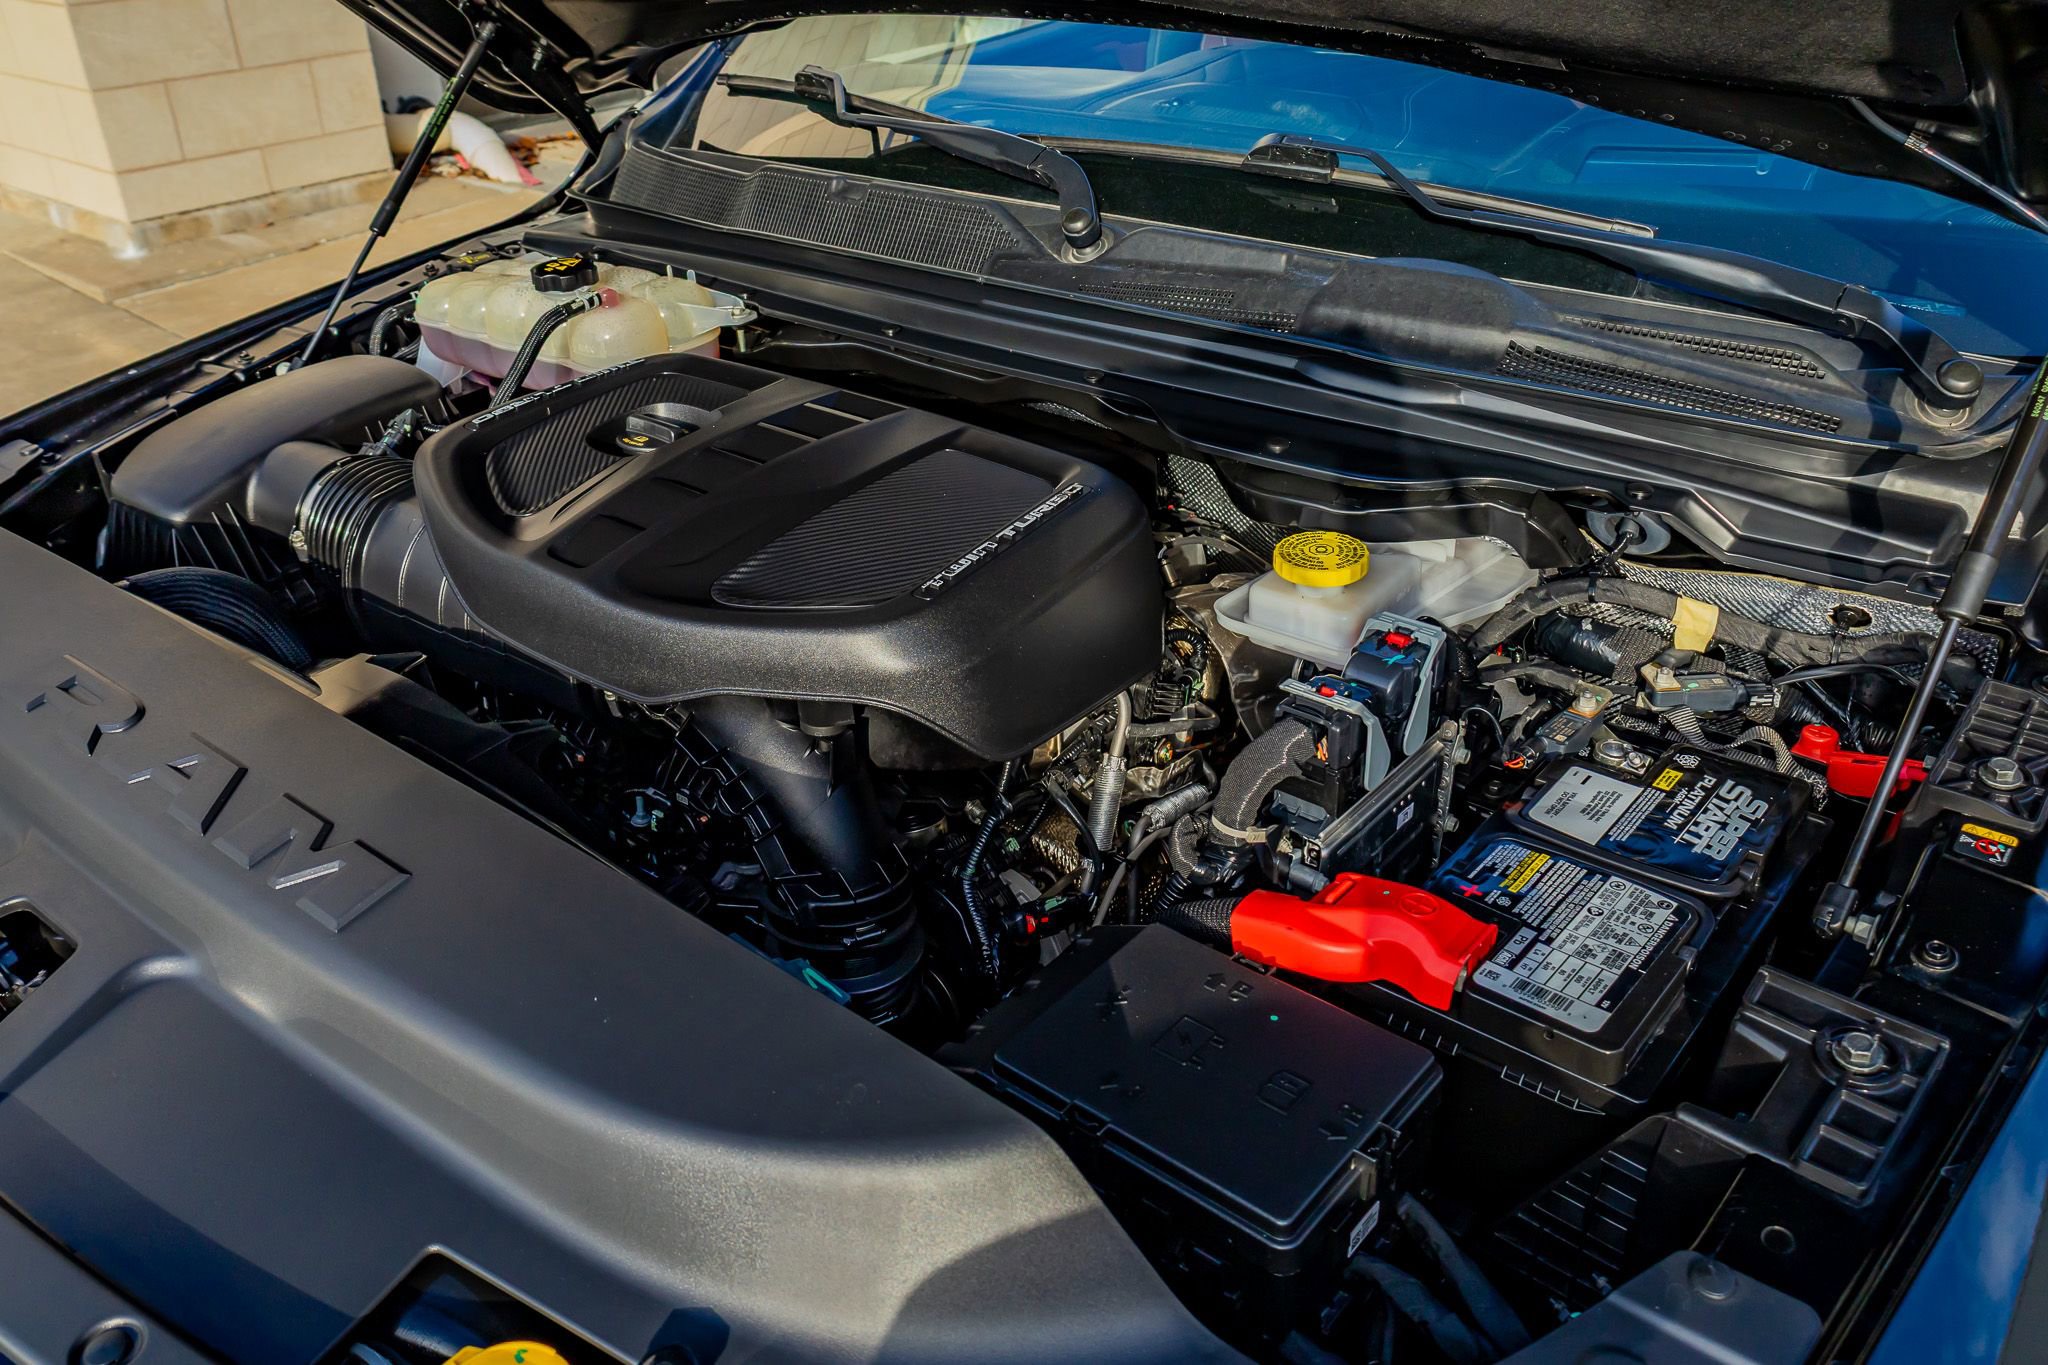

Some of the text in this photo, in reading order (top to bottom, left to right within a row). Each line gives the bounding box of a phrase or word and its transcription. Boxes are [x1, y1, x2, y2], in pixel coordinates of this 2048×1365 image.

[928, 479, 1082, 591] TWIN TURBO
[26, 654, 412, 933] RAM
[1553, 796, 1564, 804] NOT
[1664, 774, 1718, 830] PLATINUM
[1691, 778, 1753, 853] START
[1704, 797, 1769, 860] SUPER
[1494, 950, 1512, 965] AGM
[1512, 934, 1528, 946] Pb
[1518, 962, 1529, 970] H7
[1627, 920, 1674, 969] DANGER/POISON
